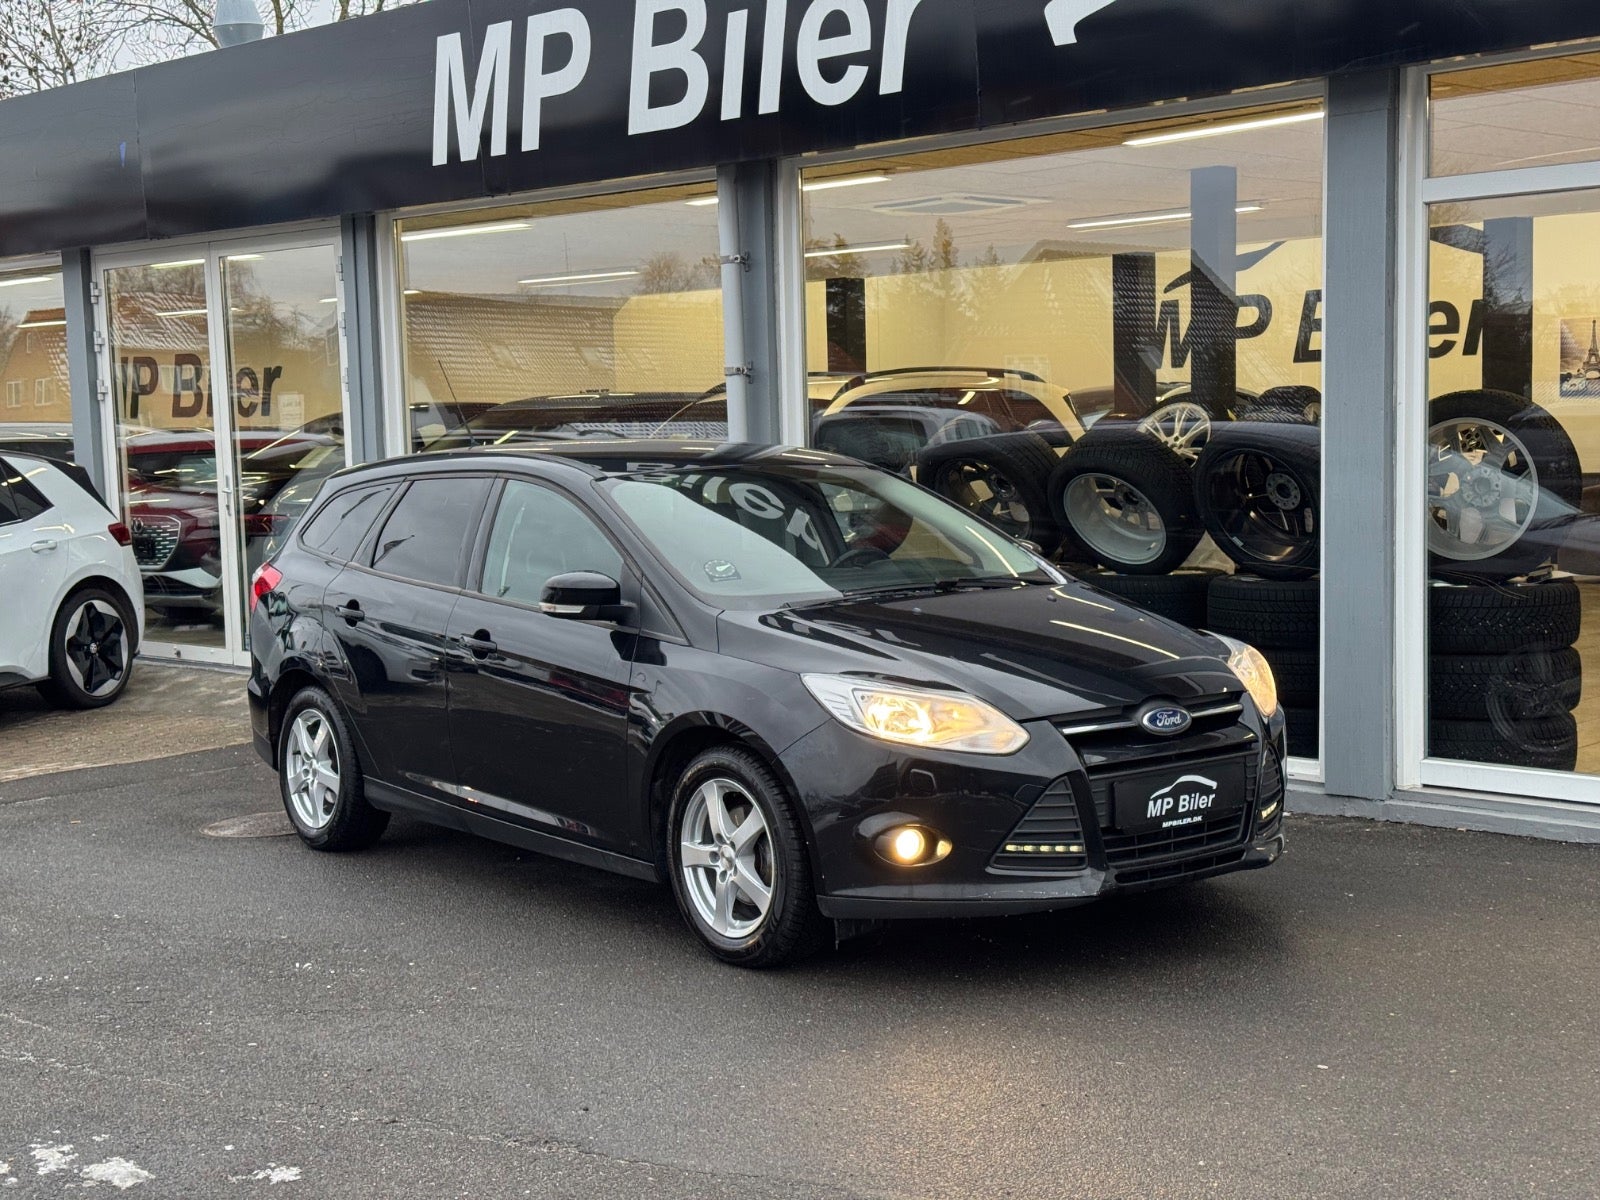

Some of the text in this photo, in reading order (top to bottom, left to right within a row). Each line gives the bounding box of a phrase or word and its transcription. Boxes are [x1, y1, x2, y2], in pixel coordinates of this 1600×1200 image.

[432, 7, 591, 166] MP
[1156, 711, 1181, 727] Ford
[1147, 793, 1216, 818] MP Biler
[1162, 816, 1202, 828] MPBILER.DK
